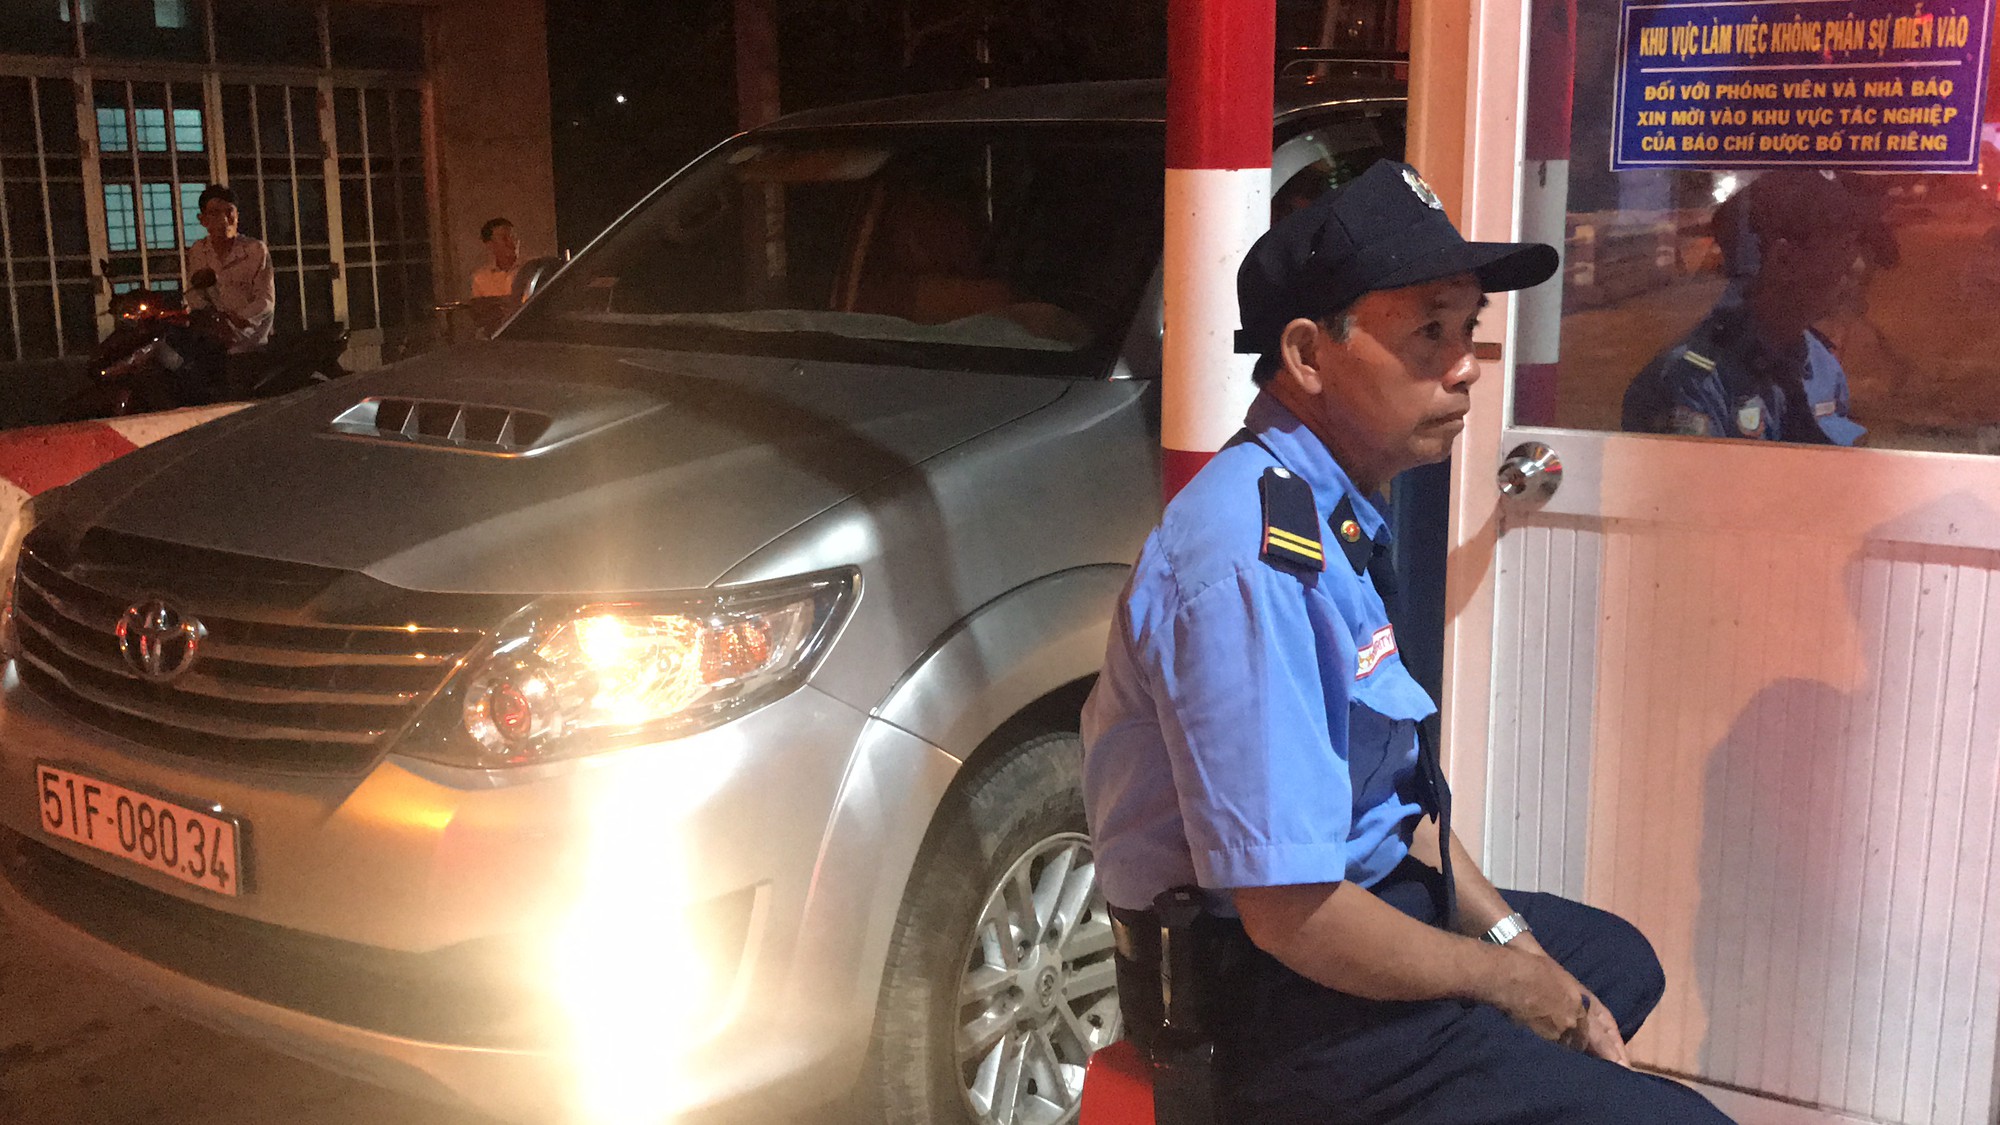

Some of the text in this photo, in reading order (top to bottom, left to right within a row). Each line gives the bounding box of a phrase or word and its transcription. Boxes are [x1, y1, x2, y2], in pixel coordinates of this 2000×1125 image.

[1640, 27, 1669, 56] KHU
[1672, 20, 1699, 62] VỰC
[1702, 16, 1733, 55] LÀM
[1736, 14, 1768, 59] VIỆC
[1771, 13, 1822, 53] KHÔNG
[1824, 12, 1866, 57] PHẬN
[1868, 12, 1892, 57] SỰ
[1937, 7, 1969, 48] VÀO
[1644, 76, 1953, 101] ĐỐI VỚI PHÓNG VIÊN VÀ NHÀ BÁO
[1637, 103, 1958, 128] XIN MỜI VÀO KHU VỰC TÁC NGHIỆP
[1641, 129, 1948, 155] CỦA BÁO CHÍ ĐƯỢC BỐ TRÍ RIÊNG
